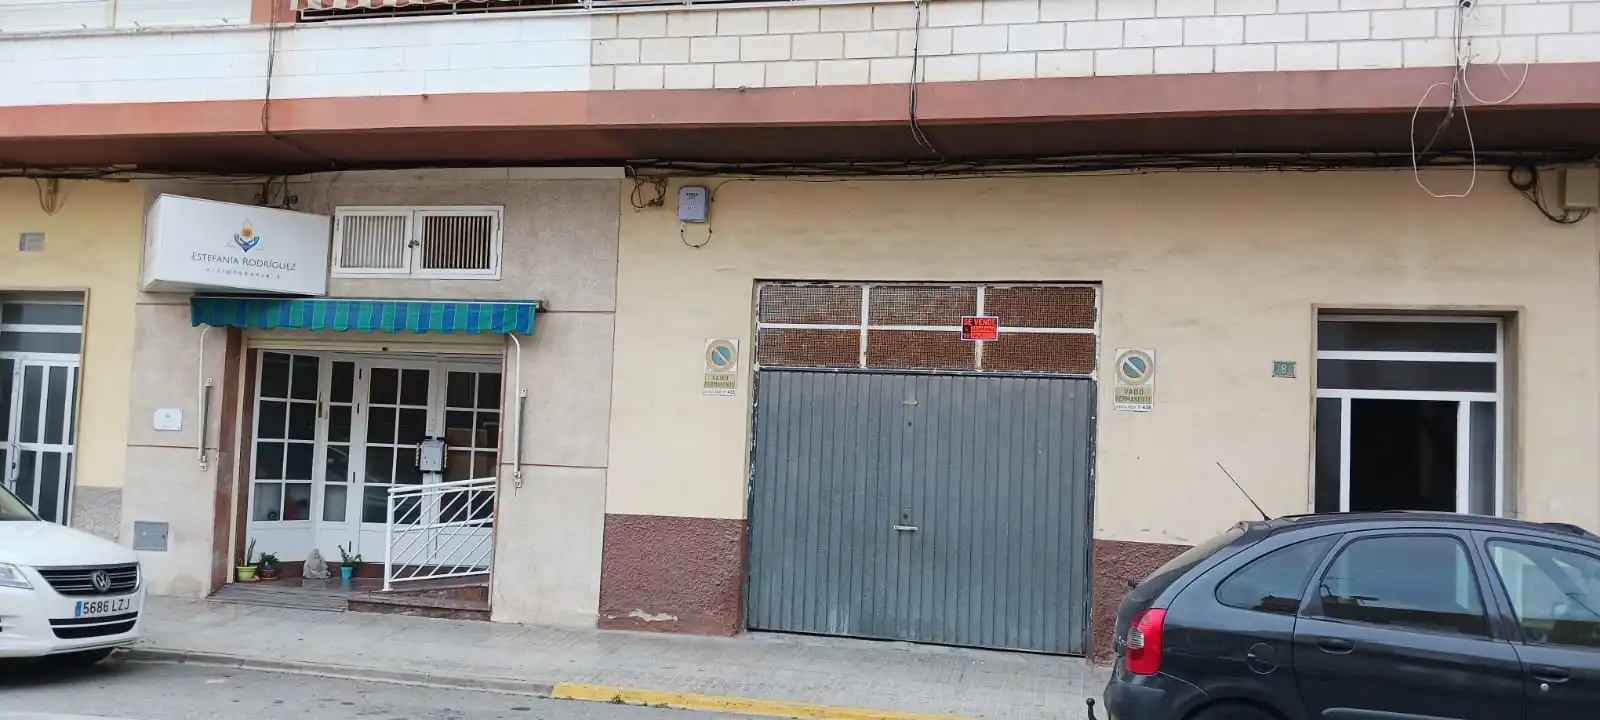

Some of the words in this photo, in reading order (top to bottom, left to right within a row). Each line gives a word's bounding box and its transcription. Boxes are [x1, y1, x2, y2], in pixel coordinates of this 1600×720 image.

[191, 251, 239, 264] ESTEFANÍA
[242, 257, 297, 271] RODRÍGUEZ
[974, 318, 997, 326] VENDE
[1281, 364, 1287, 374] 8
[83, 601, 109, 614] 5686
[111, 598, 130, 612] LZJ
